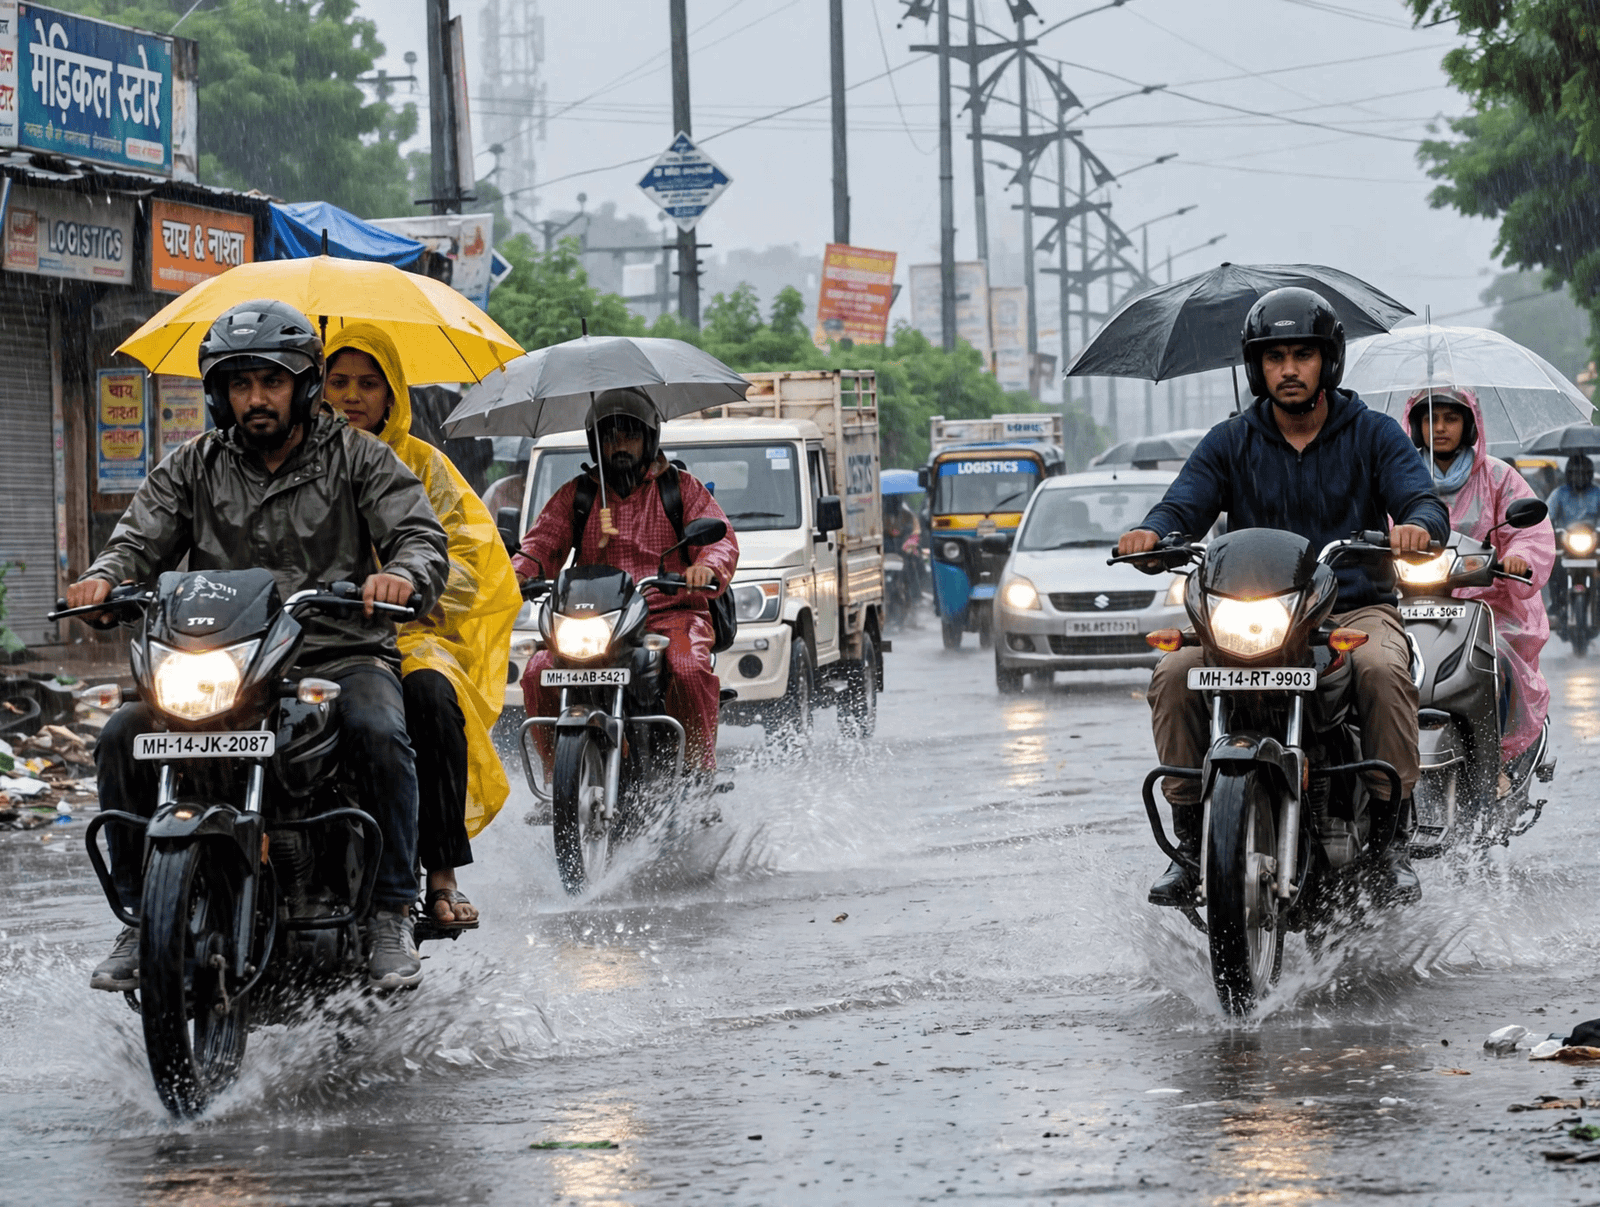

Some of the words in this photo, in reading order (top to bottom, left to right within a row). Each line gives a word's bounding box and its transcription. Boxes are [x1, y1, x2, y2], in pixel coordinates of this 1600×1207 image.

[117, 44, 163, 129] स्टोर
[48, 219, 122, 261] LOGISTICS
[162, 219, 191, 258] चाय
[194, 224, 205, 260] &
[207, 228, 245, 266] नाश्ता
[957, 461, 1019, 474] LOGISTICS
[546, 671, 625, 683] MH-14-AB-5421
[1199, 671, 1311, 686] MH-14-RT-9903
[142, 736, 269, 754] MH-14-JK-2087
